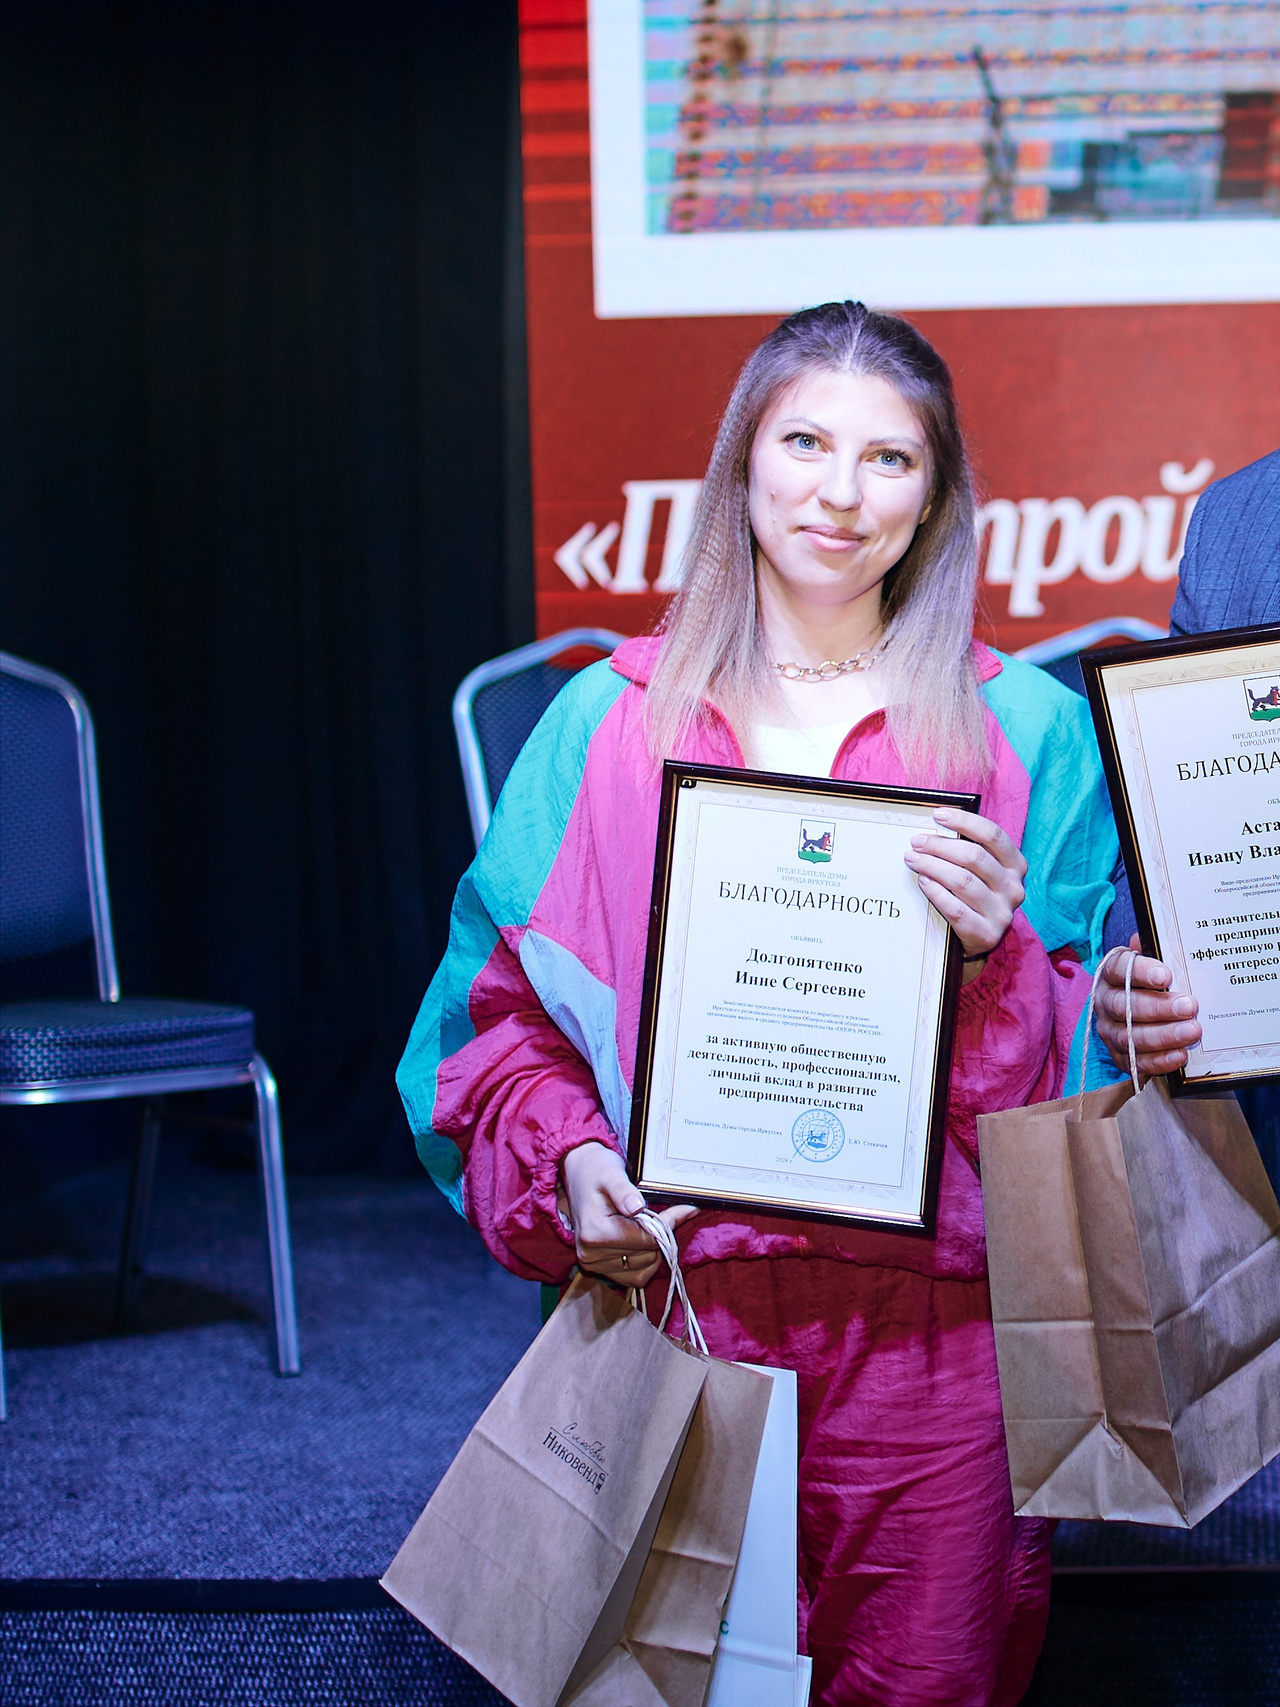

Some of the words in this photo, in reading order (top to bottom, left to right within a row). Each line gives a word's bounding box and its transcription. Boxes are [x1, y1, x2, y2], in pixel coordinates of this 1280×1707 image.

[1239, 738, 1267, 748] ГОРОДА
[1187, 850, 1243, 867] Ивану
[719, 881, 900, 918] БЛАГОДАРНОСТЬ
[1195, 919, 1209, 929] за
[745, 948, 862, 974] Долгопятенко
[1189, 942, 1274, 961] эффективную
[735, 970, 777, 988] Инне
[782, 976, 866, 998] Сергеевне
[1229, 972, 1278, 985] бизнеса
[1208, 1011, 1247, 1020] Председатель
[1248, 1008, 1265, 1016] Думы
[707, 1035, 718, 1044] за
[722, 1037, 787, 1054] активную
[790, 1043, 886, 1066] общественную
[687, 1050, 778, 1069] деятельность,
[781, 1061, 900, 1084] профессионализм,
[708, 1069, 760, 1082] личный
[764, 1075, 802, 1089] вклад
[806, 1081, 814, 1089] в
[817, 1082, 877, 1097] развитие
[718, 1086, 863, 1112] предпринимательства
